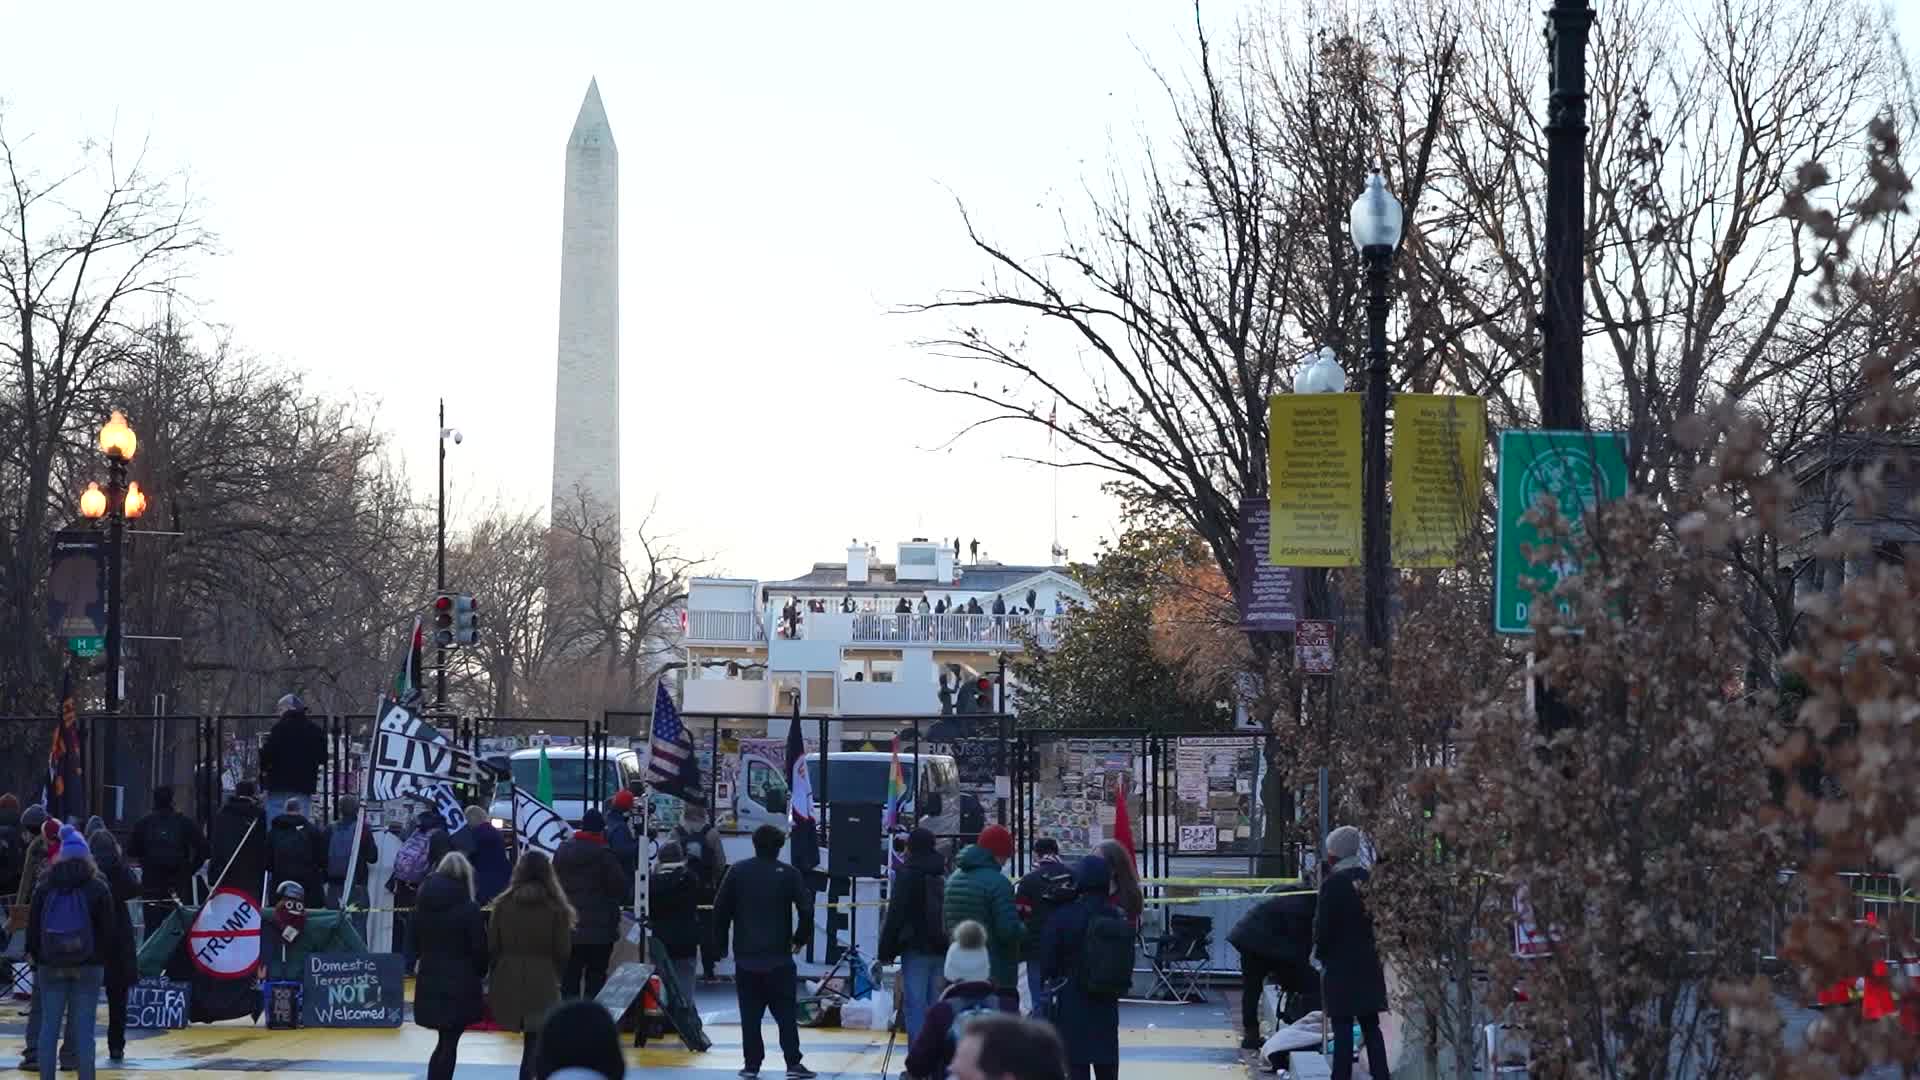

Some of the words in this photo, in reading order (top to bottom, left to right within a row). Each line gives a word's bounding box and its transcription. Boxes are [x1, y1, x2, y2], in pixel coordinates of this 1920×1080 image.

[77, 639, 87, 649] H
[196, 901, 251, 963] TRUMP
[311, 957, 376, 972] Domestic
[126, 1005, 184, 1027] SCUM
[315, 1006, 385, 1022] Welcomed
